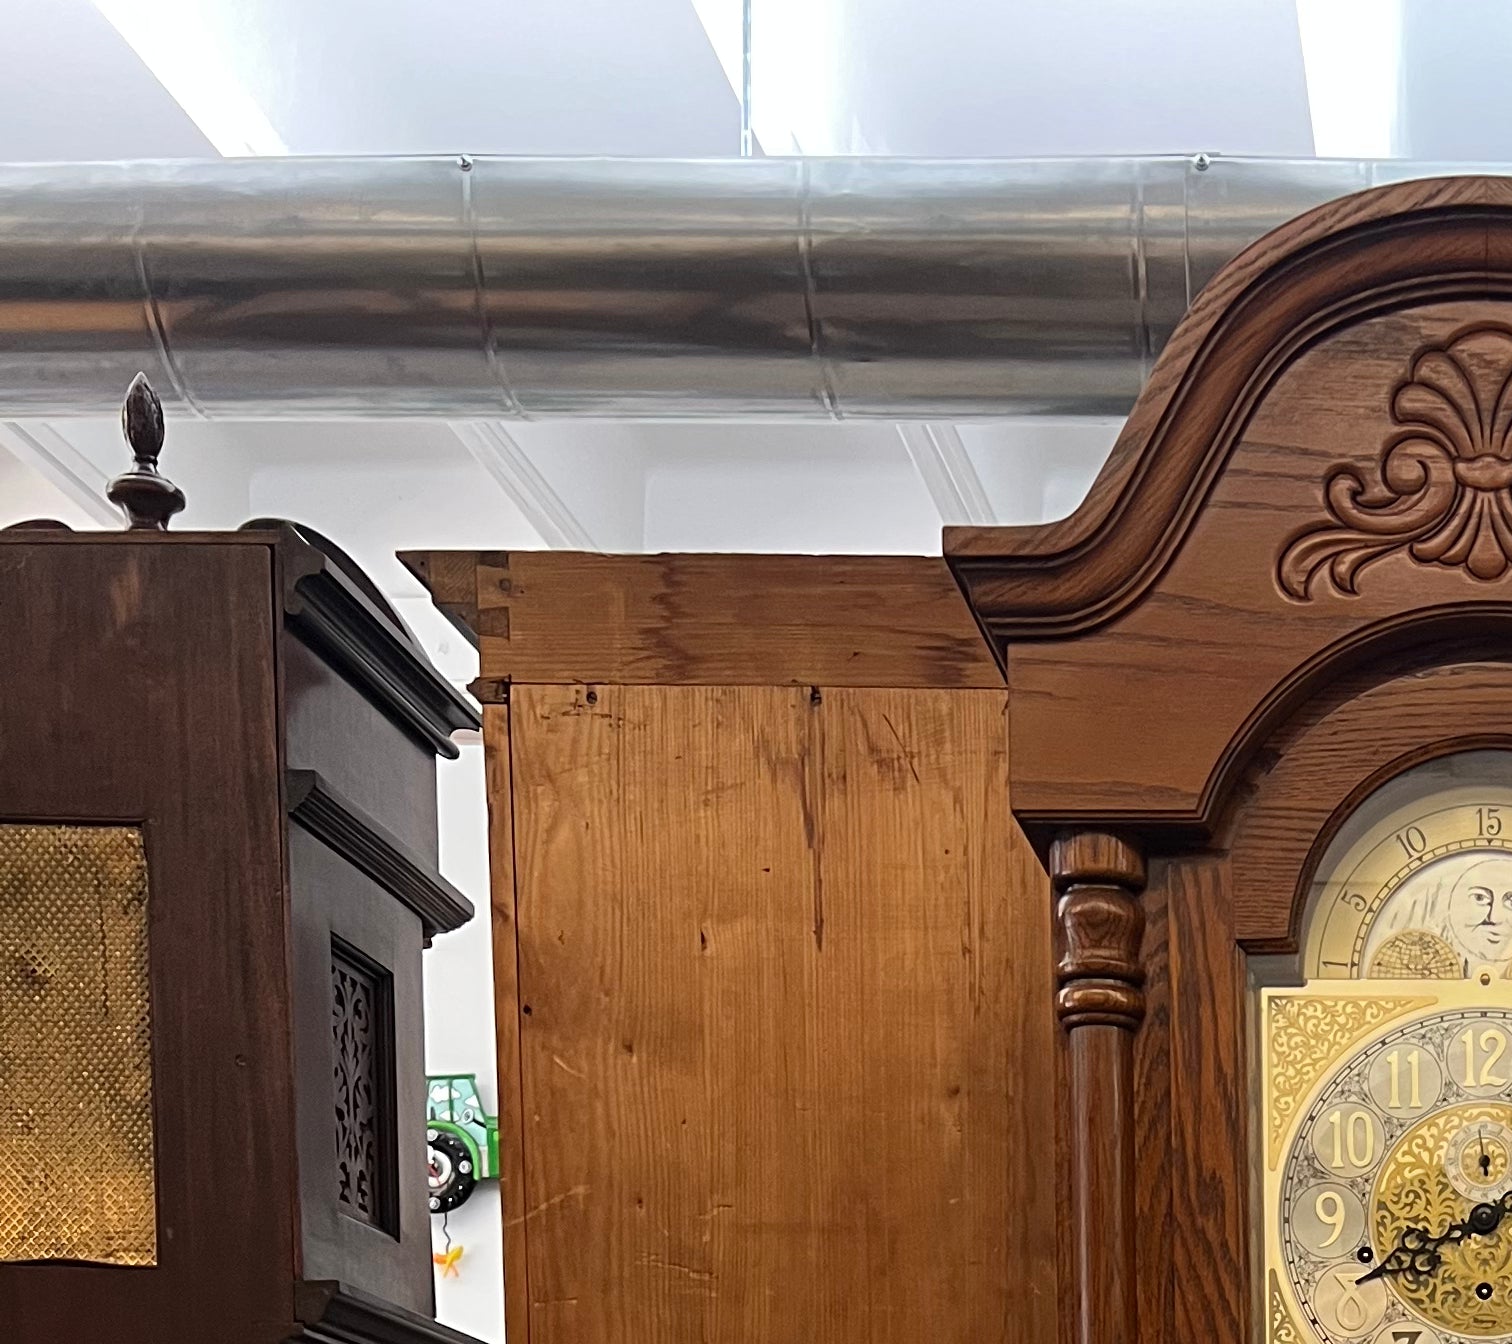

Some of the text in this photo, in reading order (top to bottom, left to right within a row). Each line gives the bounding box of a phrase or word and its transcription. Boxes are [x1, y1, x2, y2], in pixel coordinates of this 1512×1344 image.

[1396, 827, 1427, 858] 10
[1476, 808, 1502, 836] 15
[1341, 889, 1367, 912] 5
[1322, 960, 1349, 970] 1
[1386, 1050, 1423, 1109] 11
[1461, 1029, 1507, 1088] 12
[1329, 1110, 1375, 1168] 10
[1315, 1191, 1346, 1249] 9
[1333, 1272, 1369, 1332] 8
